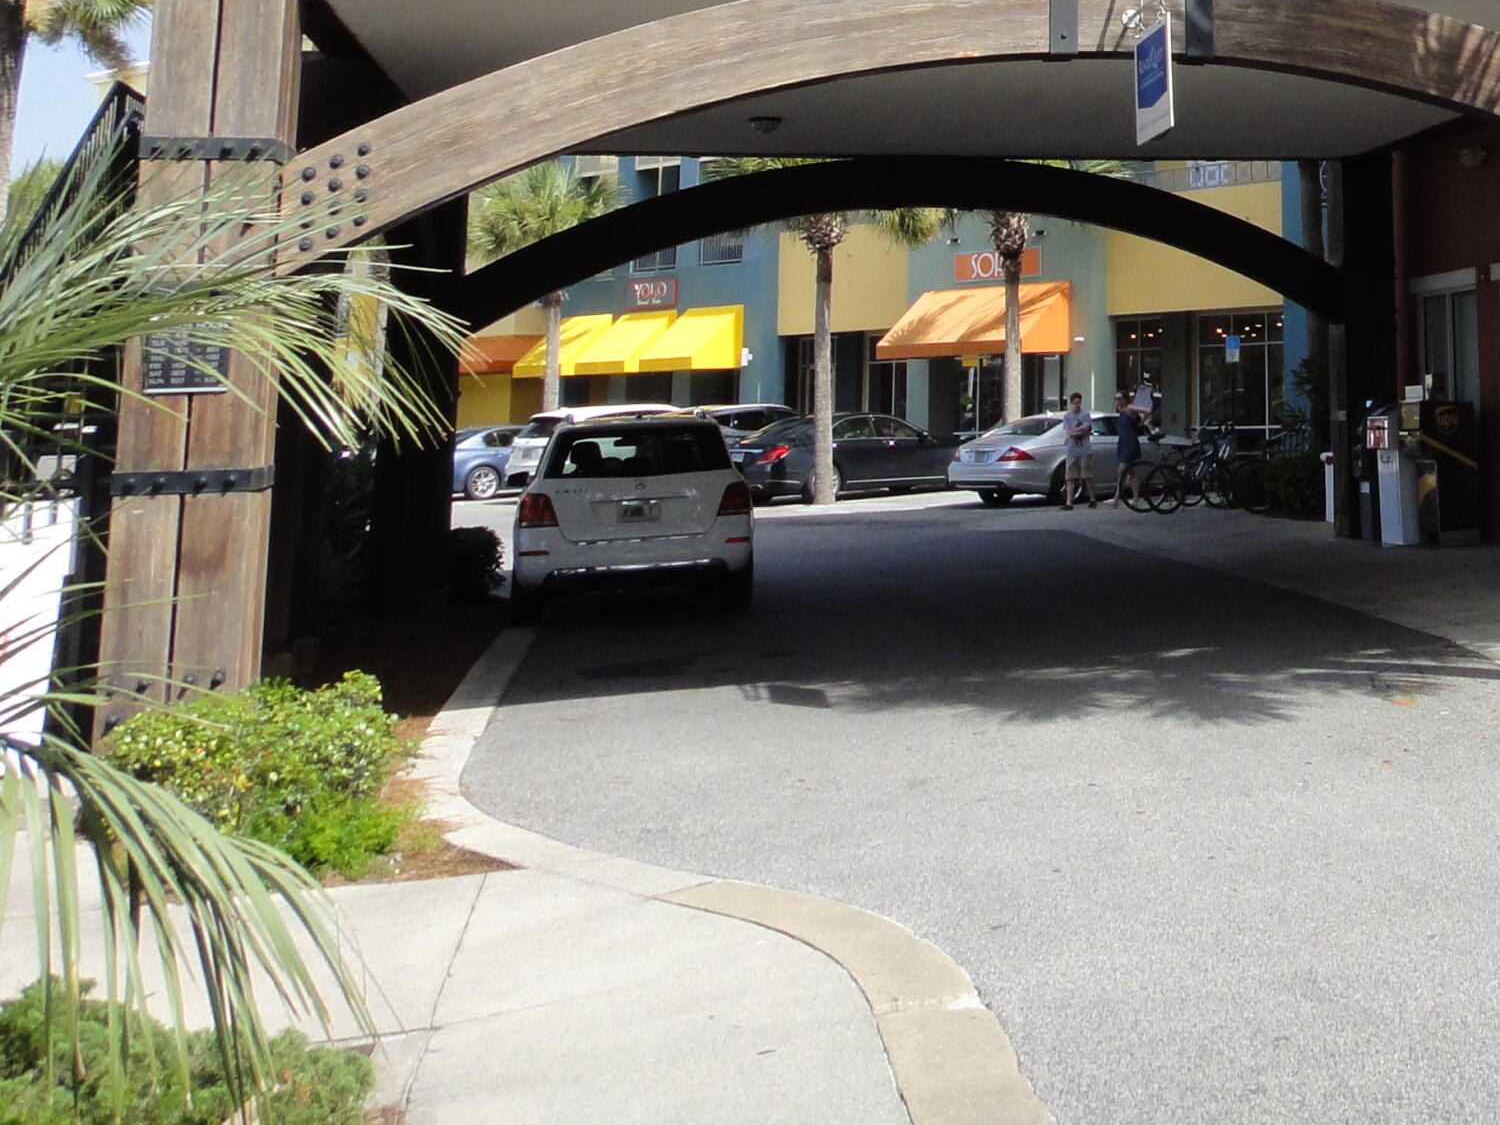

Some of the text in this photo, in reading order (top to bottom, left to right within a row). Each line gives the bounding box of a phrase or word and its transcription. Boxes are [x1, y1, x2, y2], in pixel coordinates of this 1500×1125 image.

[970, 252, 1008, 279] SOH
[633, 281, 668, 300] YOLO
[1435, 413, 1458, 431] ups
